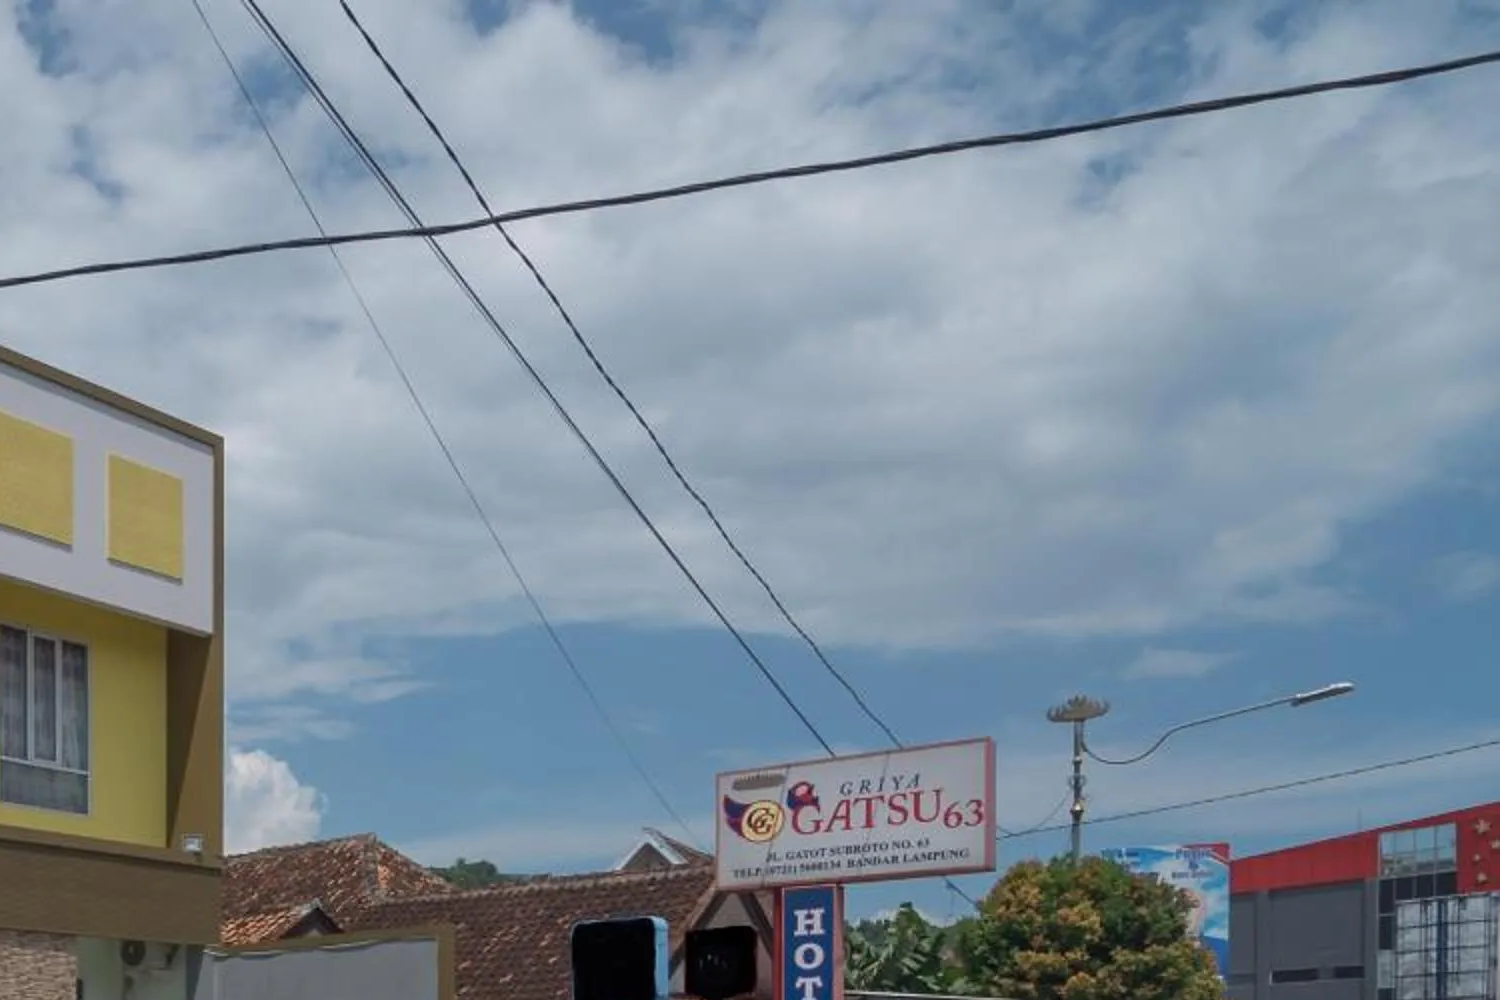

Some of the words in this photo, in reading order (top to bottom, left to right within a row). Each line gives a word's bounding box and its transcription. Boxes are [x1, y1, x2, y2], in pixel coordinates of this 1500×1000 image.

[839, 773, 920, 796] GRIYA
[784, 847, 828, 861] GATOT
[829, 840, 889, 857] SUBROTO
[892, 838, 915, 850] NO.
[847, 855, 900, 868] BANDAR
[902, 846, 971, 864] LAMPUNG
